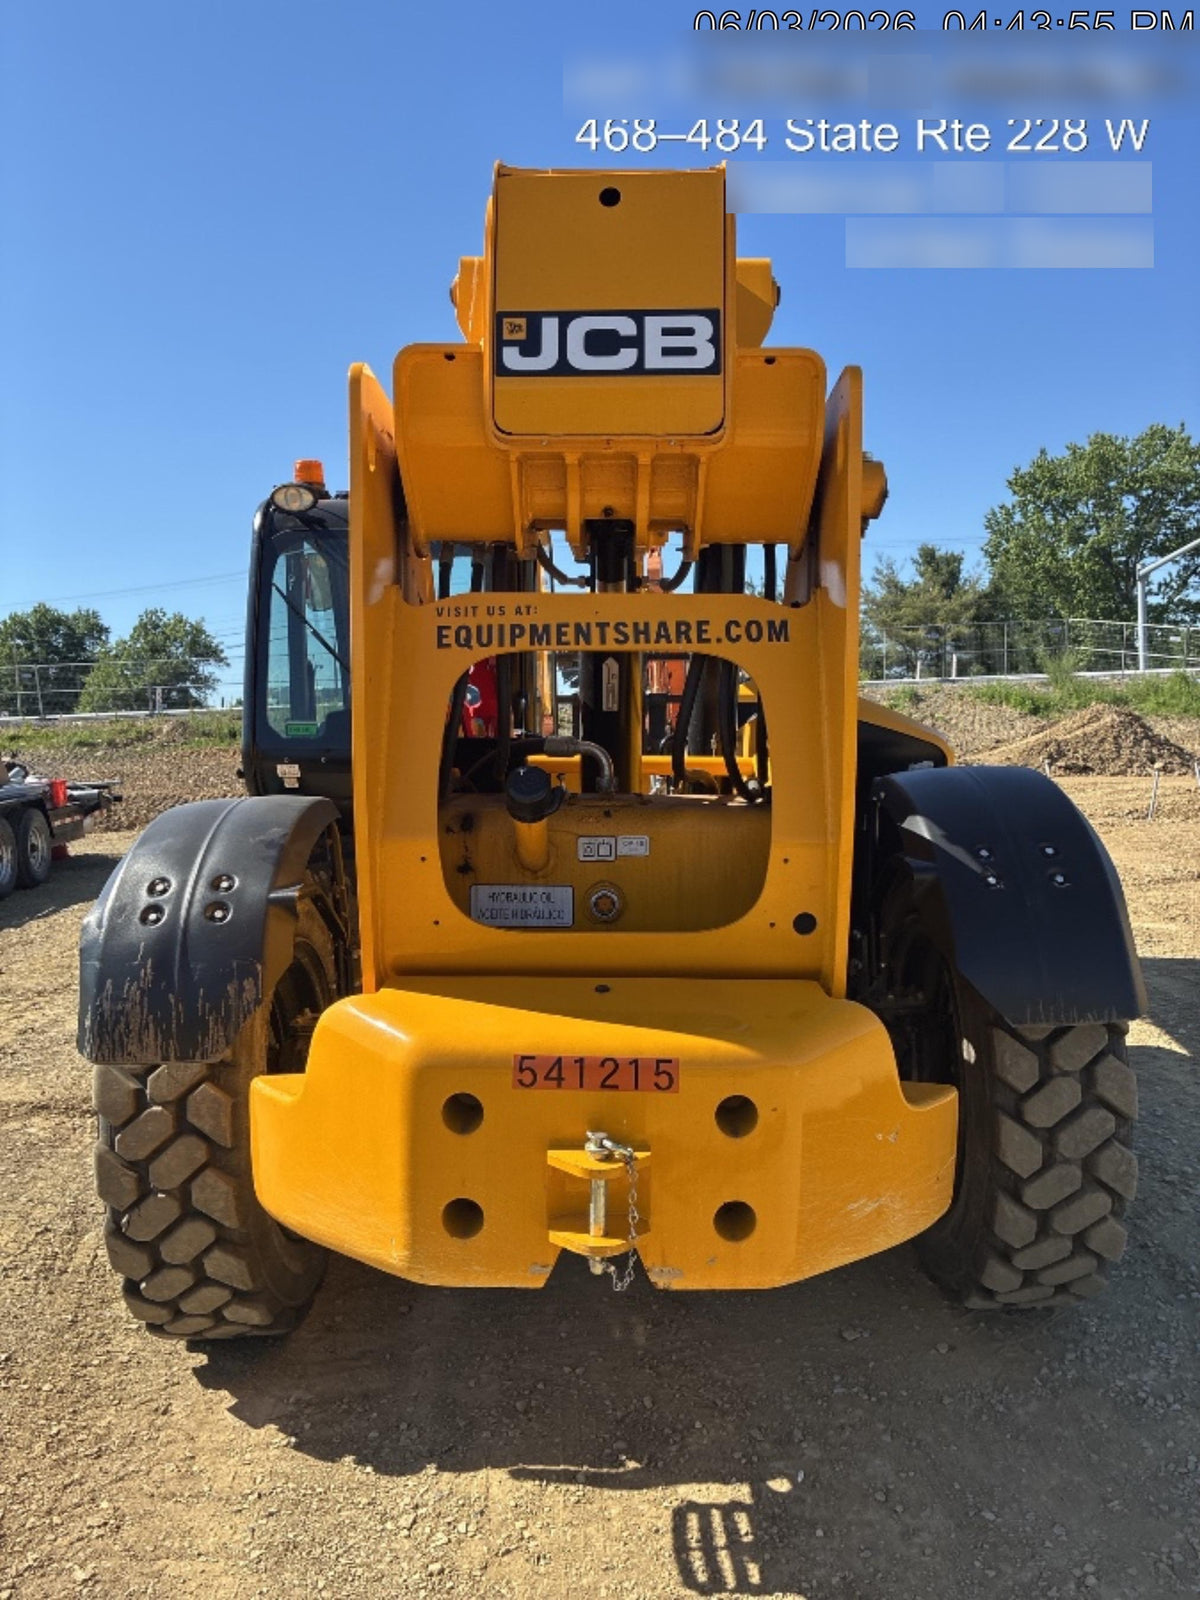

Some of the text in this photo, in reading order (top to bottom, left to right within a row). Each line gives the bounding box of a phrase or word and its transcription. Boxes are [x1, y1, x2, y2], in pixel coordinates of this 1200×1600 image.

[502, 315, 716, 371] JCB
[436, 605, 538, 617] VISIT US AT:
[436, 619, 790, 649] EQUIPMENTSHARE.COM
[517, 1056, 674, 1091] 541215
